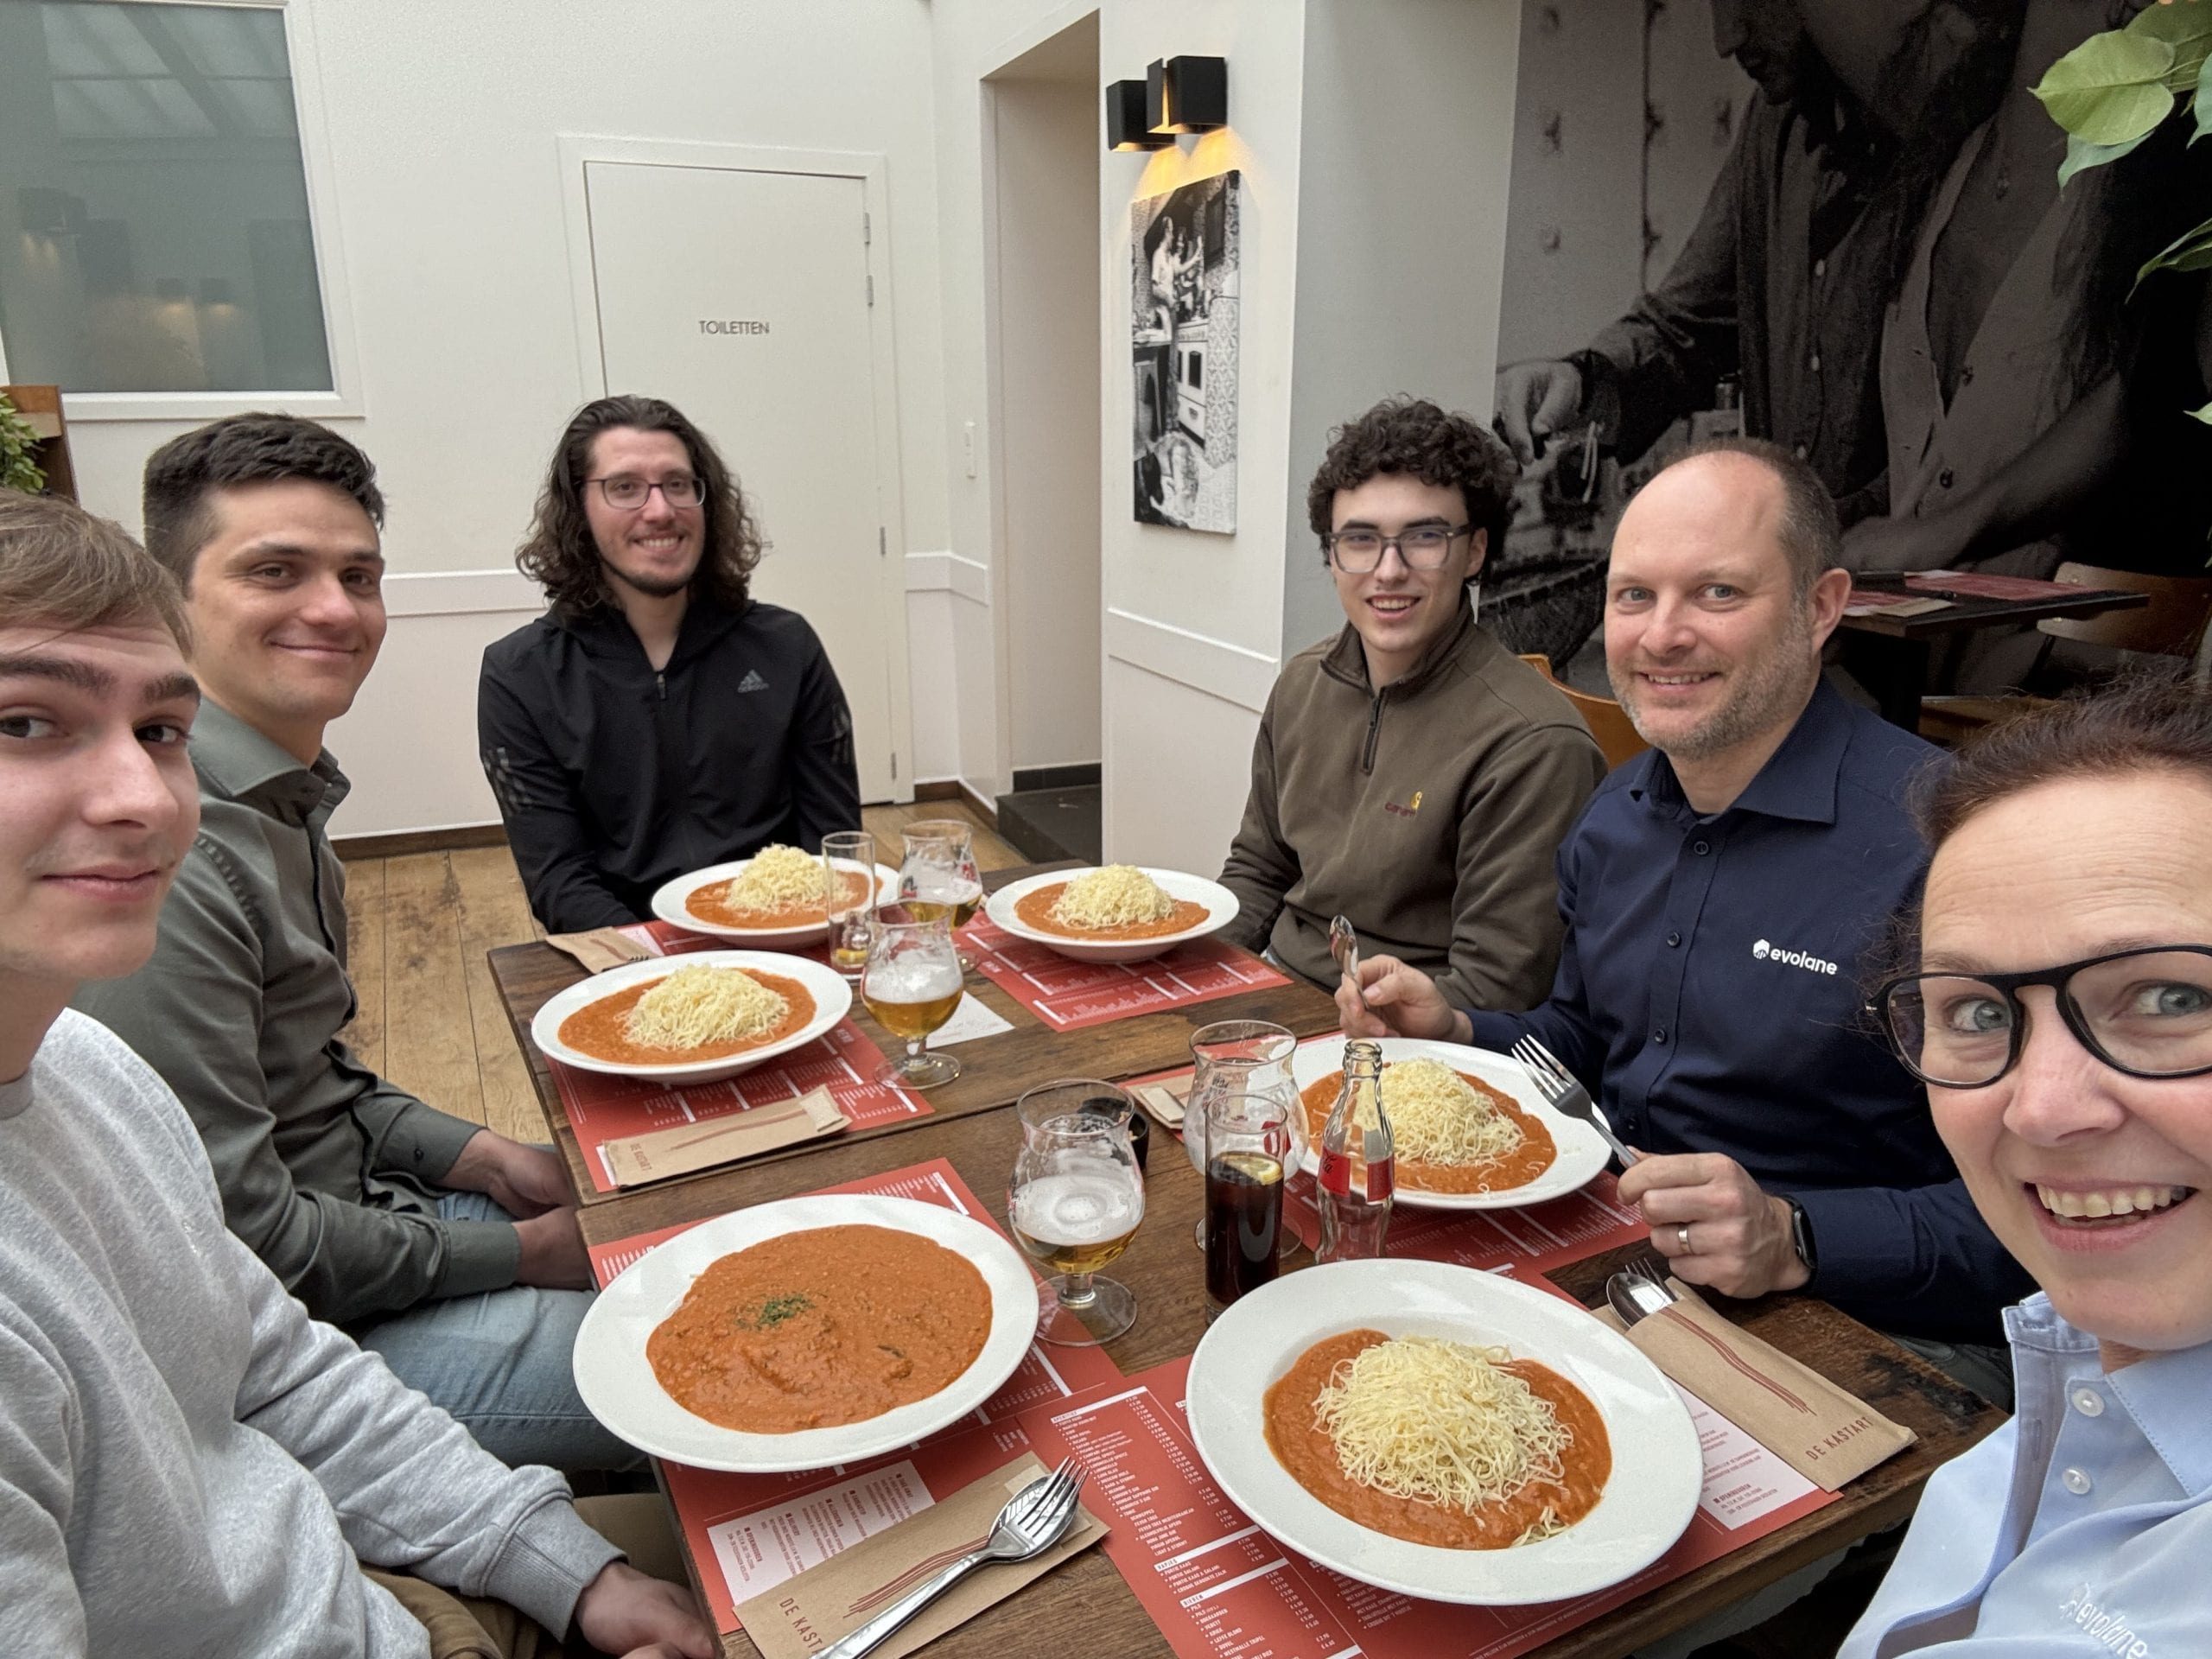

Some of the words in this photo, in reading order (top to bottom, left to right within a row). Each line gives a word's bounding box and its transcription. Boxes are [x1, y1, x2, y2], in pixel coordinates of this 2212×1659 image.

[699, 320, 770, 335] TOILETTEN
[1770, 948, 1838, 976] evolane
[1805, 1445, 1827, 1460] DE
[1823, 1416, 1874, 1449] KASTART
[779, 1597, 799, 1617] DE
